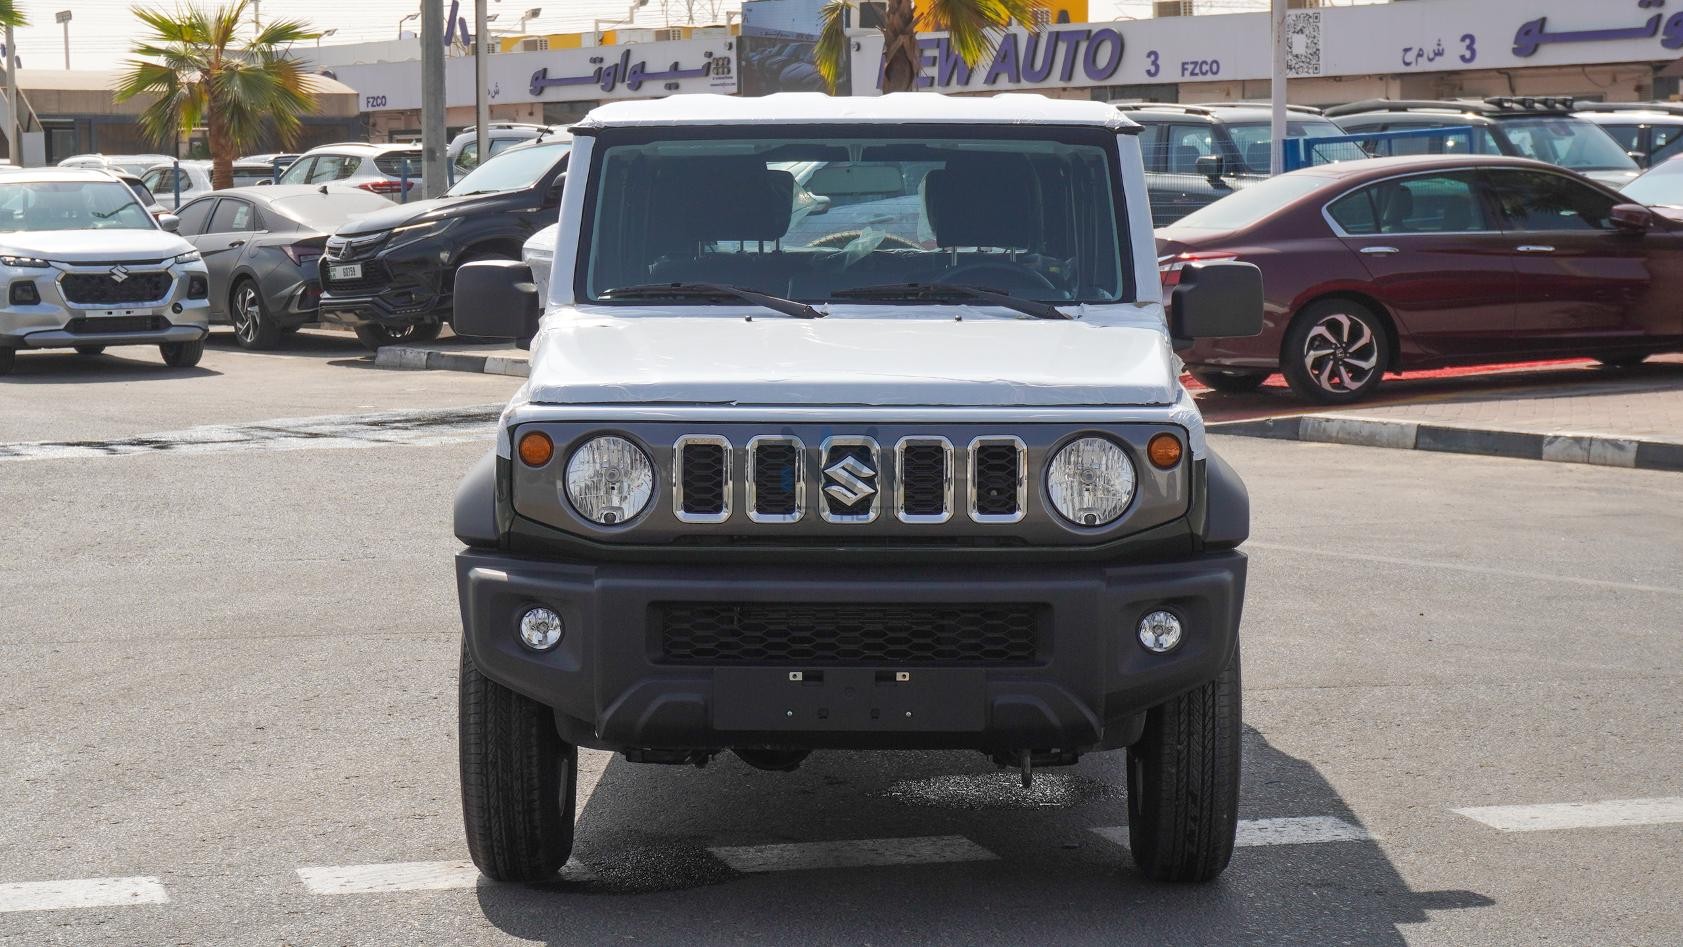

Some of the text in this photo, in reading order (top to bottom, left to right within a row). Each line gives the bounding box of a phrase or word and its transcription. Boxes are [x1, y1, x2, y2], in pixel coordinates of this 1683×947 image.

[876, 27, 1220, 90] EW AUTO 3 FZCO
[1459, 33, 1477, 64] 3
[366, 95, 387, 108] FZCO
